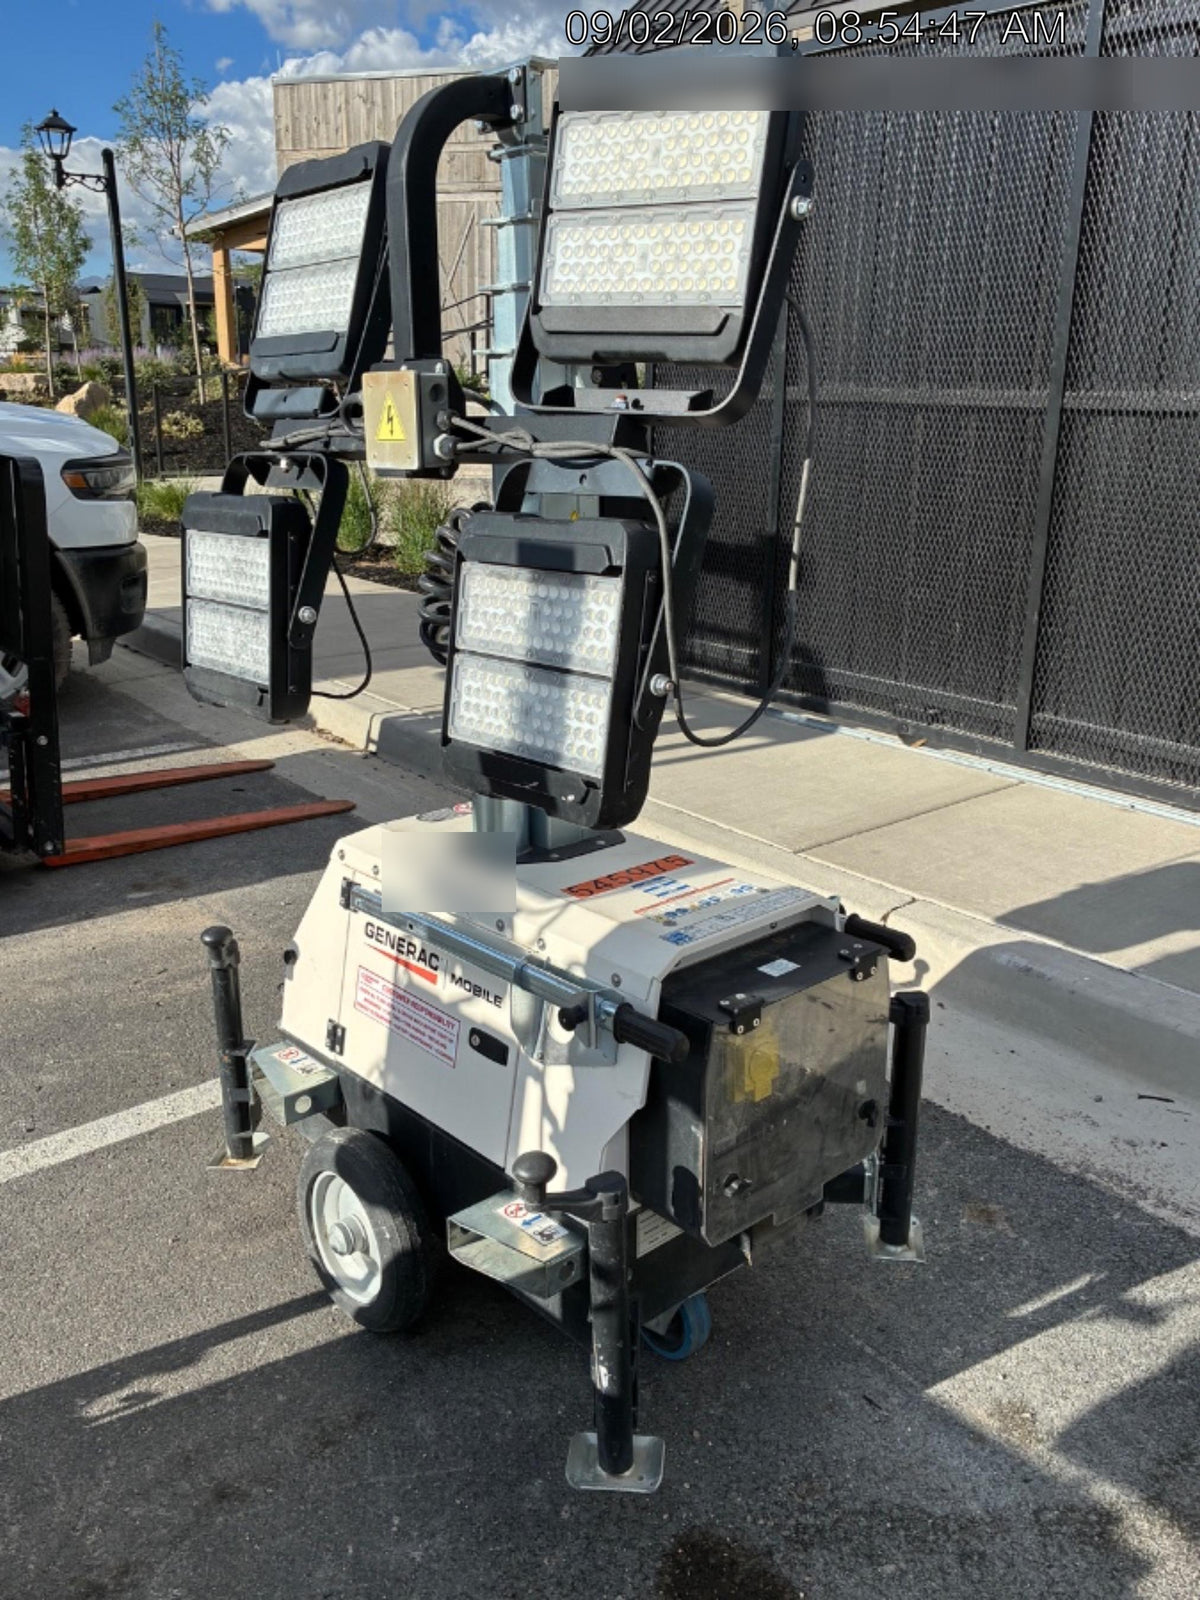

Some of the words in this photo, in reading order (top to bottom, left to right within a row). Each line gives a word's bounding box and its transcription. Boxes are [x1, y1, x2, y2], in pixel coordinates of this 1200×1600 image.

[566, 854, 690, 897] 545975
[364, 921, 440, 971] GENERAC
[450, 972, 503, 1009] MOBILE
